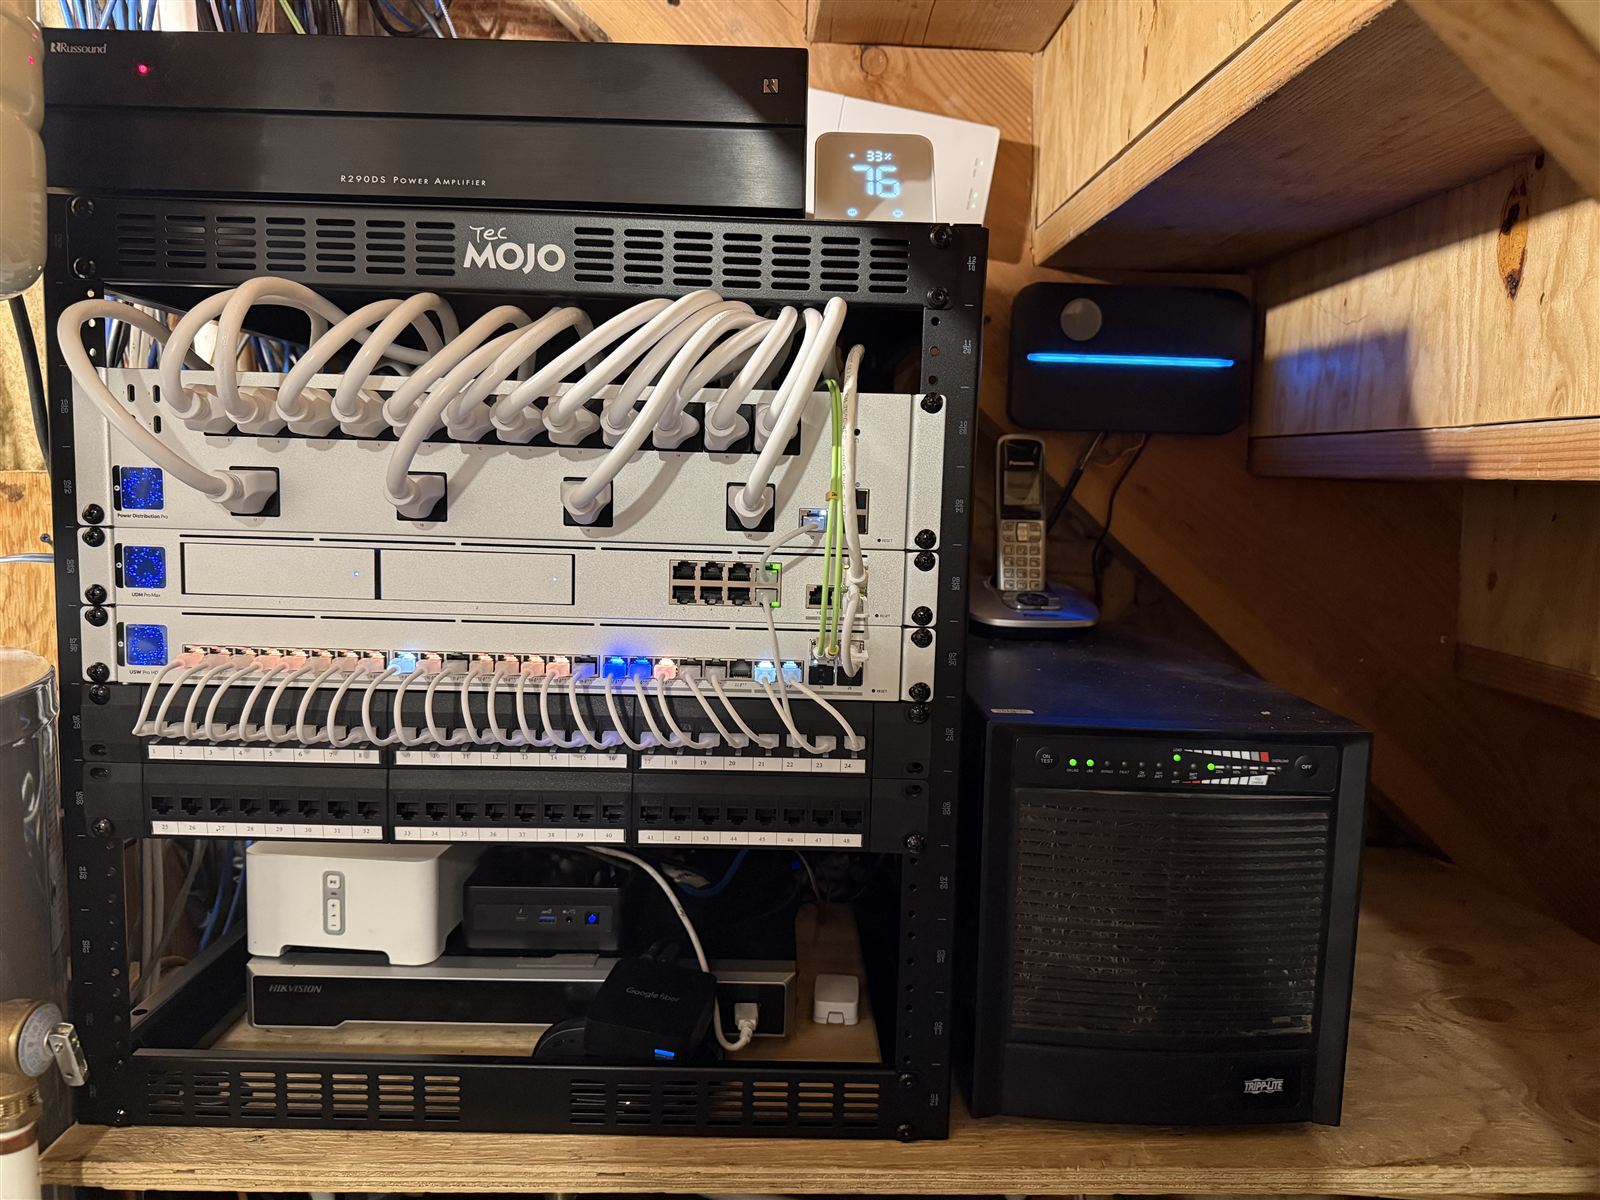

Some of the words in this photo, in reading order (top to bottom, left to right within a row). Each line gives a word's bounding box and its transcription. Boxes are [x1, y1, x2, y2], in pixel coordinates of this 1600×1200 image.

[60, 42, 107, 53] Russound
[867, 151, 892, 162] 33%
[340, 175, 386, 184] R290DS
[852, 165, 901, 198] 76
[463, 240, 566, 275] MOJO
[269, 984, 322, 993] HIKVISION
[626, 987, 659, 999] Google
[1243, 1079, 1284, 1094] TRIPP-LITE
